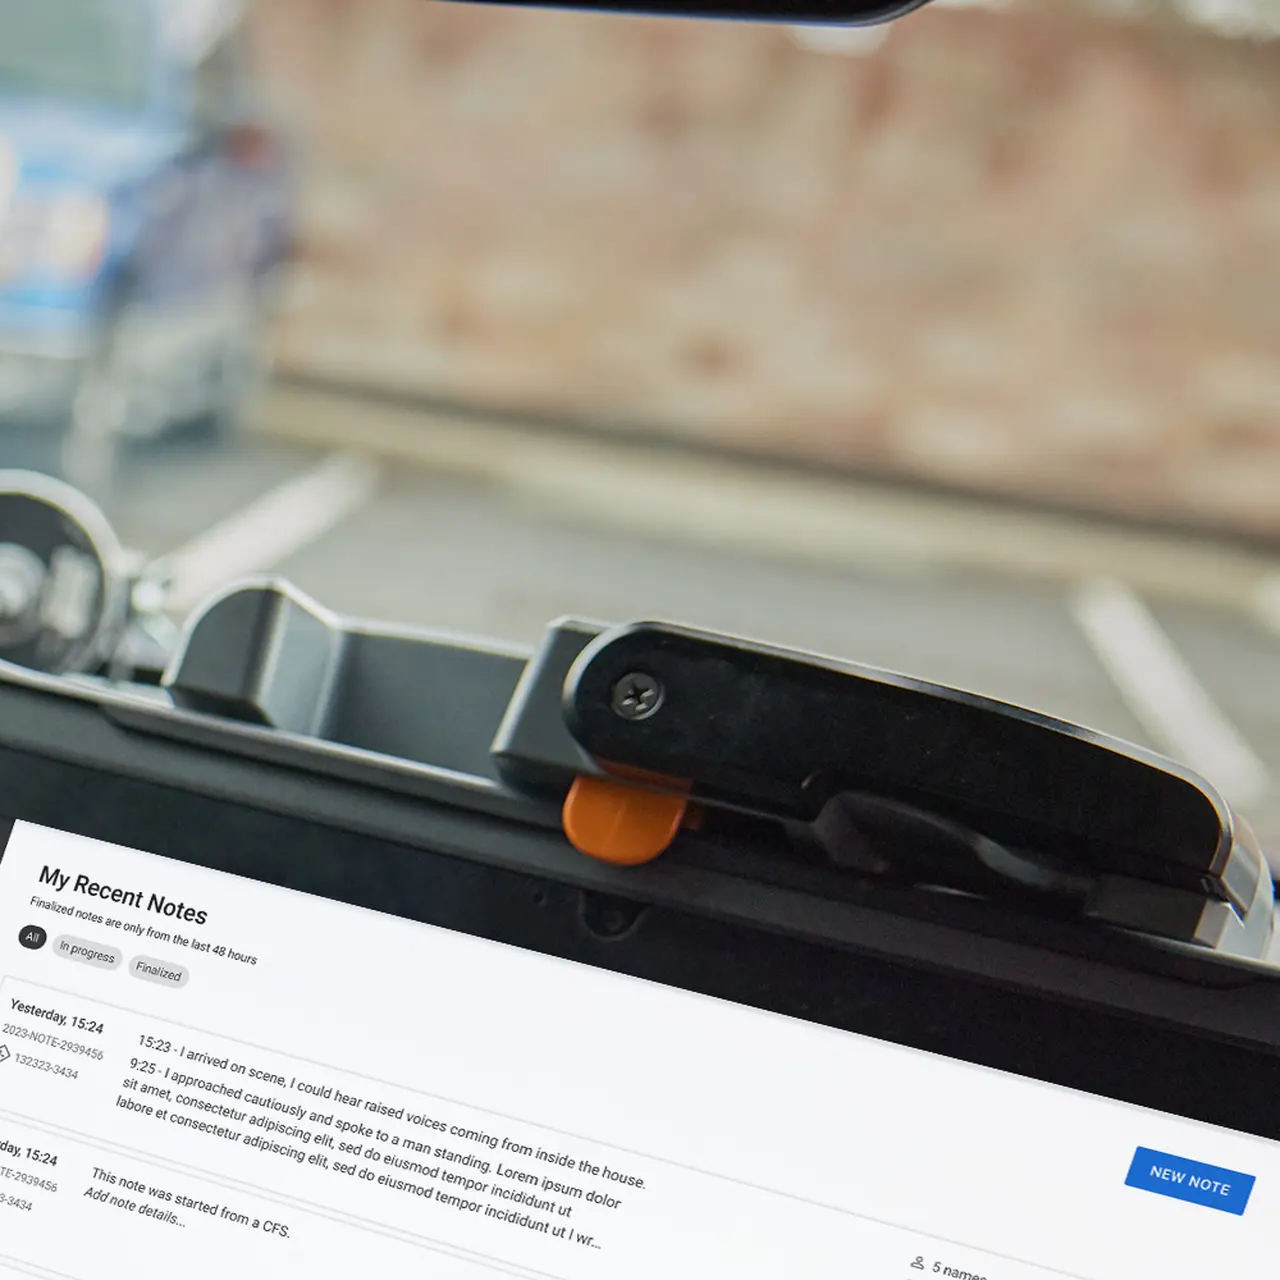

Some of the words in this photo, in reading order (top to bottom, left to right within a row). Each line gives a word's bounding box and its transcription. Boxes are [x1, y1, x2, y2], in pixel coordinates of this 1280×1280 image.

[38, 865, 71, 892] My
[73, 874, 144, 909] Recent
[146, 893, 208, 925] Notes
[25, 931, 40, 943] All
[29, 895, 75, 916] Finalized
[74, 910, 104, 924] notes
[104, 917, 123, 929] are
[123, 922, 146, 937] only
[145, 926, 171, 942] from
[172, 934, 190, 947] the
[190, 938, 211, 953] last
[212, 945, 227, 957] 48
[227, 947, 258, 966] hours
[59, 940, 70, 951] In
[69, 945, 115, 964] progress
[135, 961, 183, 982] Finalized
[11, 997, 67, 1026] Yesterday,
[72, 1016, 104, 1035] 15:24
[1, 1023, 104, 1061] 2023-NOTE-2939456
[15, 1052, 79, 1080] 132323-3434
[26, 1147, 58, 1167] 15:24
[1149, 1165, 1187, 1184] NEW
[1188, 1175, 1231, 1196] NOTE
[83, 1187, 111, 1203] Add
[109, 1196, 137, 1212] note
[92, 1167, 117, 1185] This
[118, 1178, 147, 1194] note
[148, 1186, 173, 1202] was
[174, 1195, 219, 1216] started
[220, 1206, 250, 1225] from
[251, 1219, 260, 1229] a
[262, 1220, 290, 1239] CFS.
[932, 1261, 942, 1273] 5
